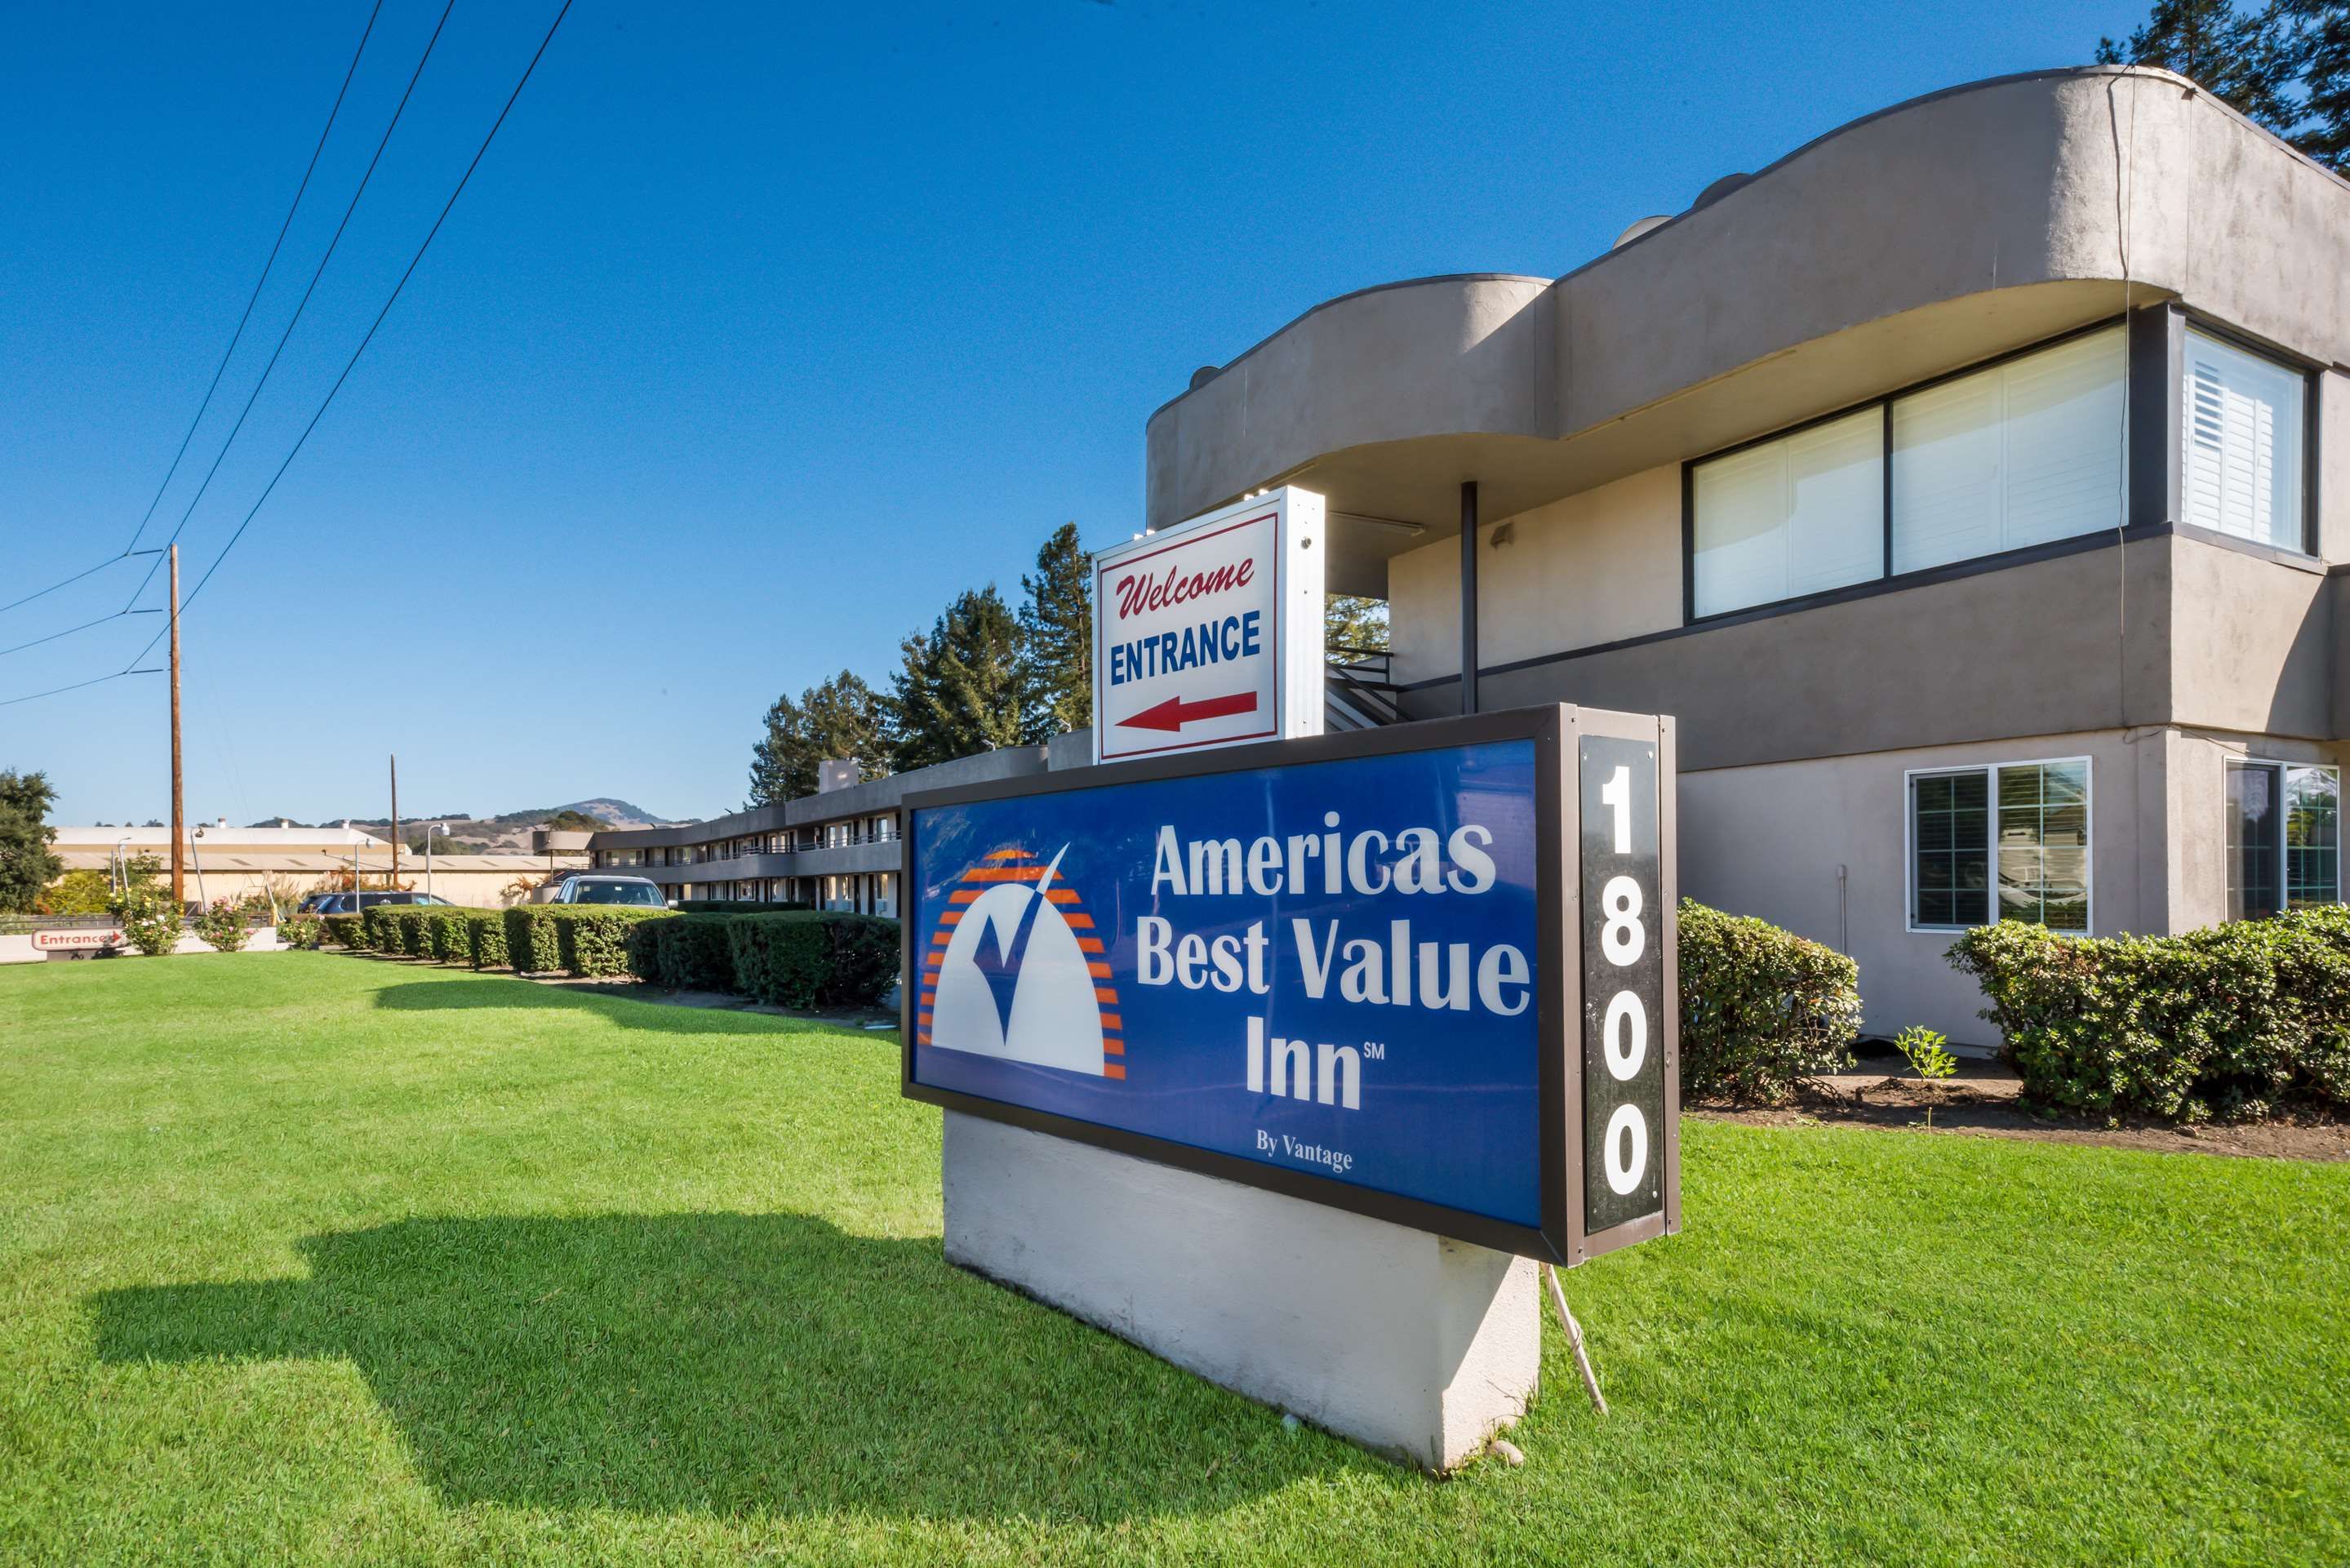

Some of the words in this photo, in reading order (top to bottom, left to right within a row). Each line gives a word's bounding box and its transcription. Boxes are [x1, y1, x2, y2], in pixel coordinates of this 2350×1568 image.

[1116, 557, 1255, 620] Welcome
[1110, 610, 1260, 686] ENTRANCE
[1150, 811, 1496, 895] Americas
[40, 935, 106, 945] Entrance
[1136, 916, 1270, 995] Best
[1291, 918, 1530, 1016] Value
[1601, 764, 1648, 1196] 1800
[1246, 1015, 1361, 1111] Inn
[1256, 1129, 1278, 1157] By
[1282, 1135, 1353, 1174] Vantage
